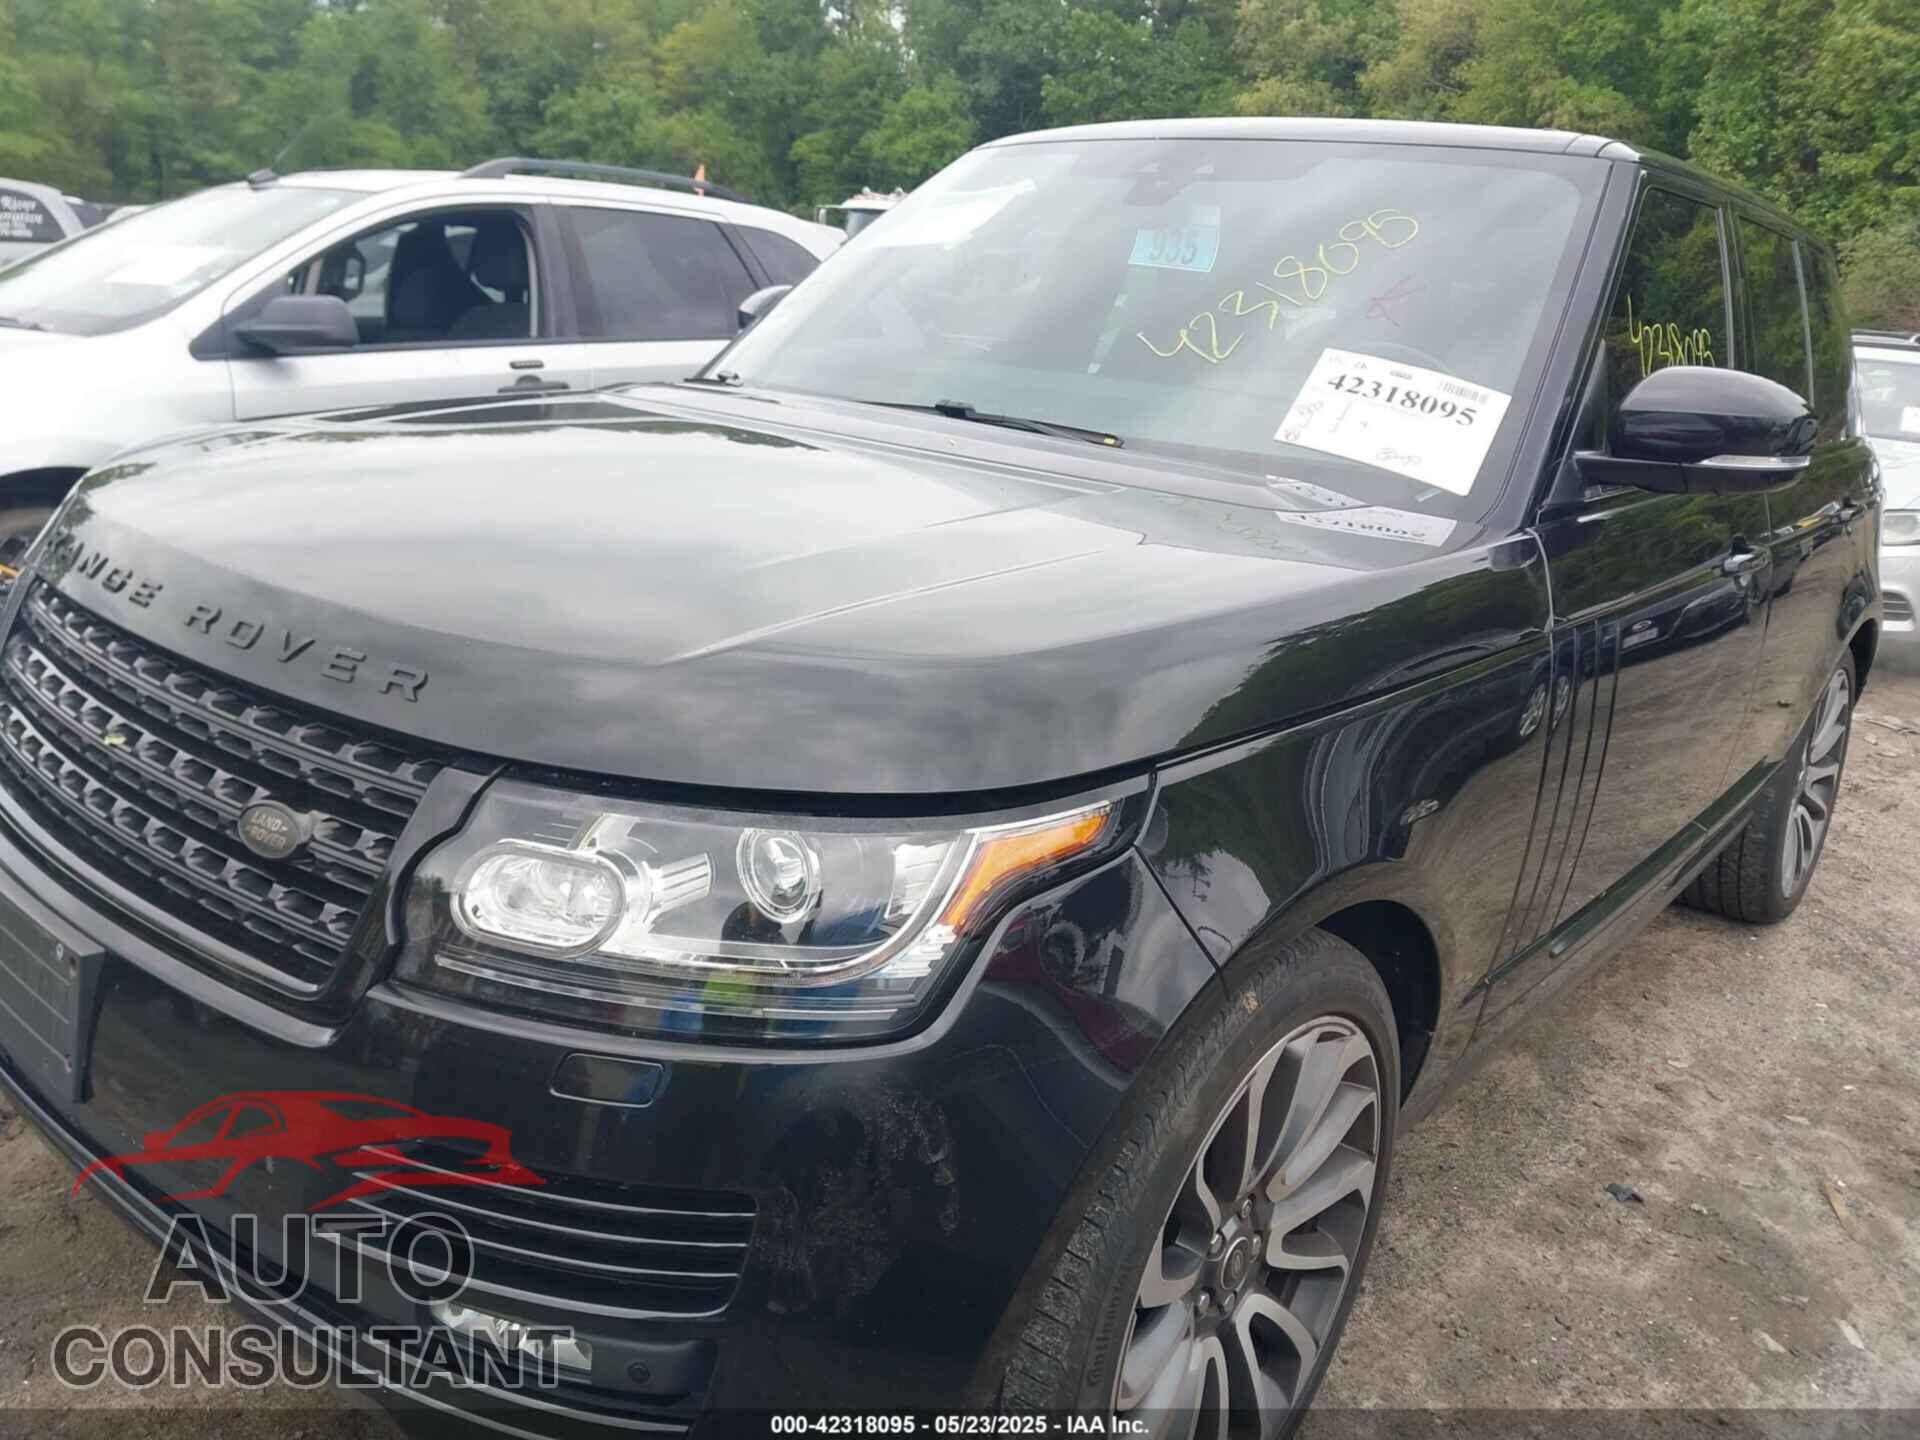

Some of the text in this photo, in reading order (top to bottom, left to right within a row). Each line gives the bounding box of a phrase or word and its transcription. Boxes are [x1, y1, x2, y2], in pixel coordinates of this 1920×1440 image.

[1136, 207, 1419, 364] 42318095
[1327, 372, 1478, 427] 42318095
[183, 604, 430, 704] ROVER
